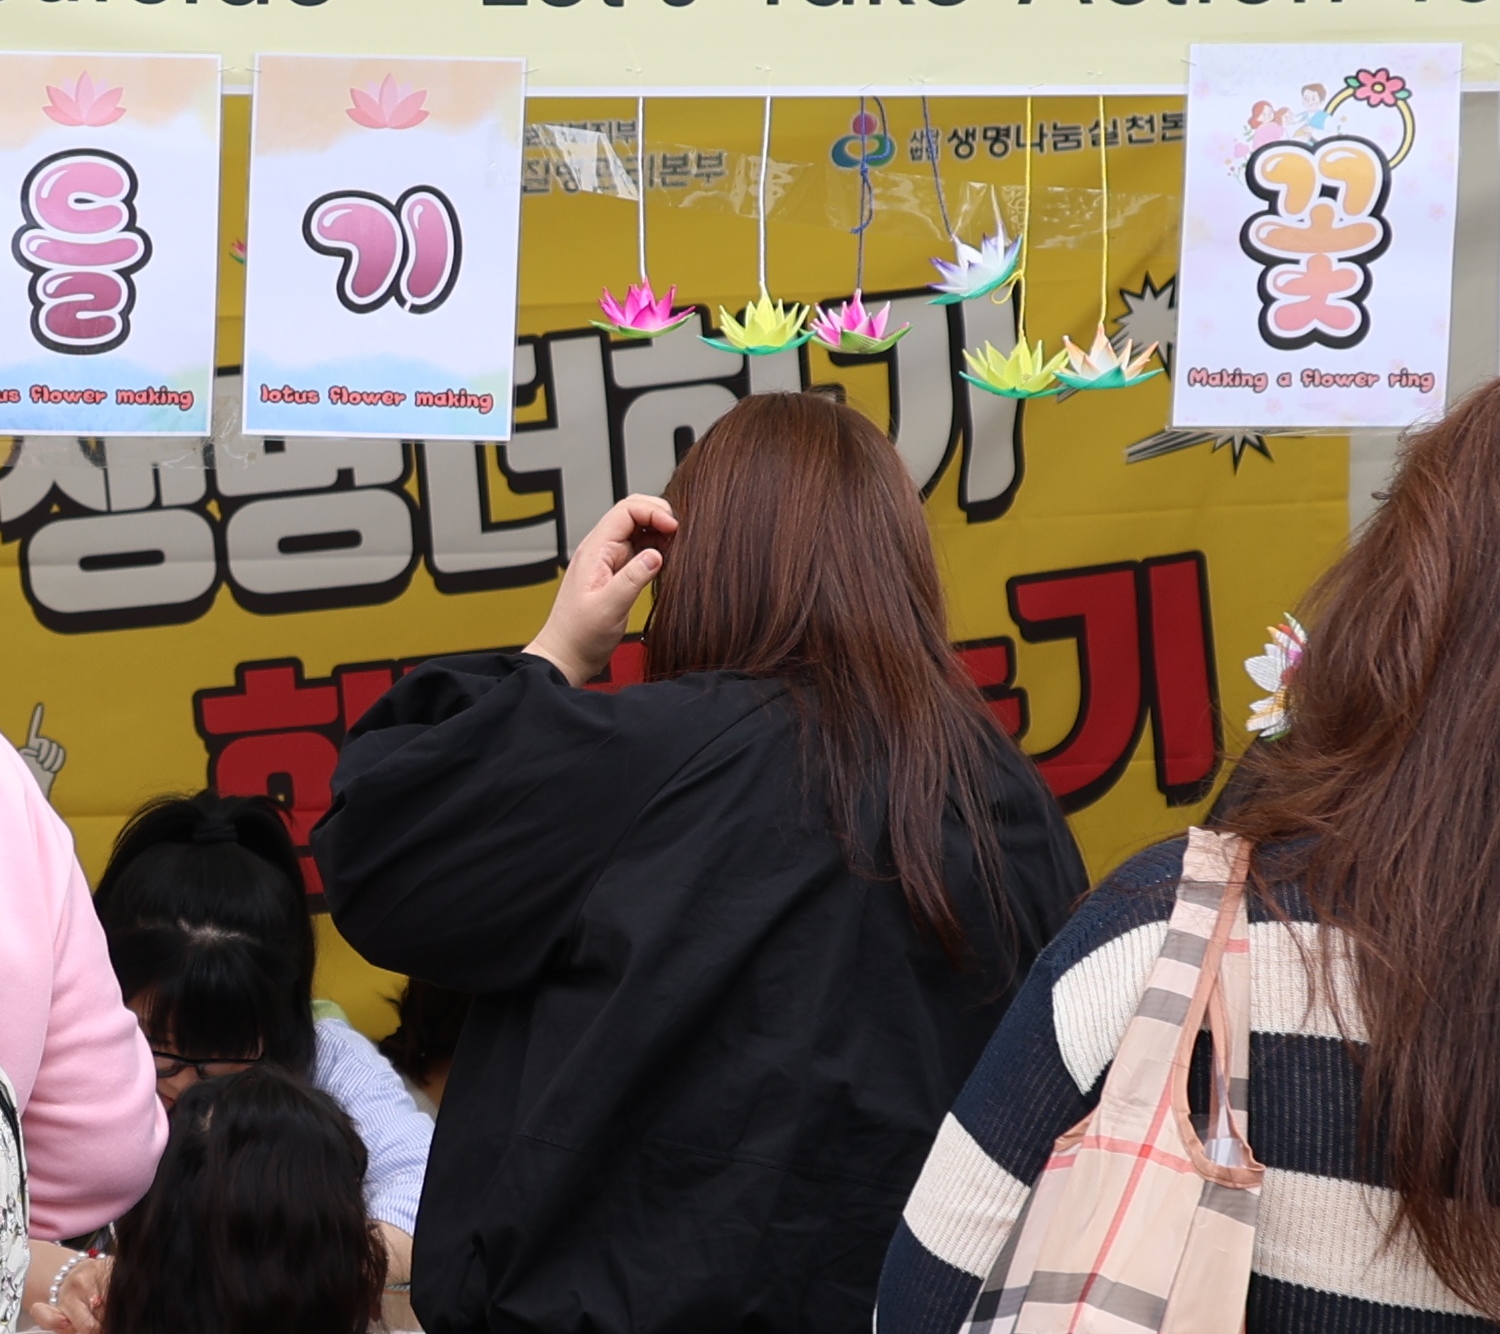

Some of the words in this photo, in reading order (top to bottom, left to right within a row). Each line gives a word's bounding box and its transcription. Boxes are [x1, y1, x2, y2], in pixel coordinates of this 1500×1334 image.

[11, 148, 152, 355] 들
[302, 185, 462, 314] 기
[1240, 134, 1394, 351] 꽃
[1187, 367, 1269, 393] Making
[1278, 371, 1294, 389] a
[1300, 368, 1380, 391] flower
[1388, 367, 1436, 394] ring
[29, 383, 108, 405] flower
[115, 386, 195, 411] making
[259, 384, 320, 405] lotus
[328, 385, 406, 406] flower
[414, 388, 494, 414] making
